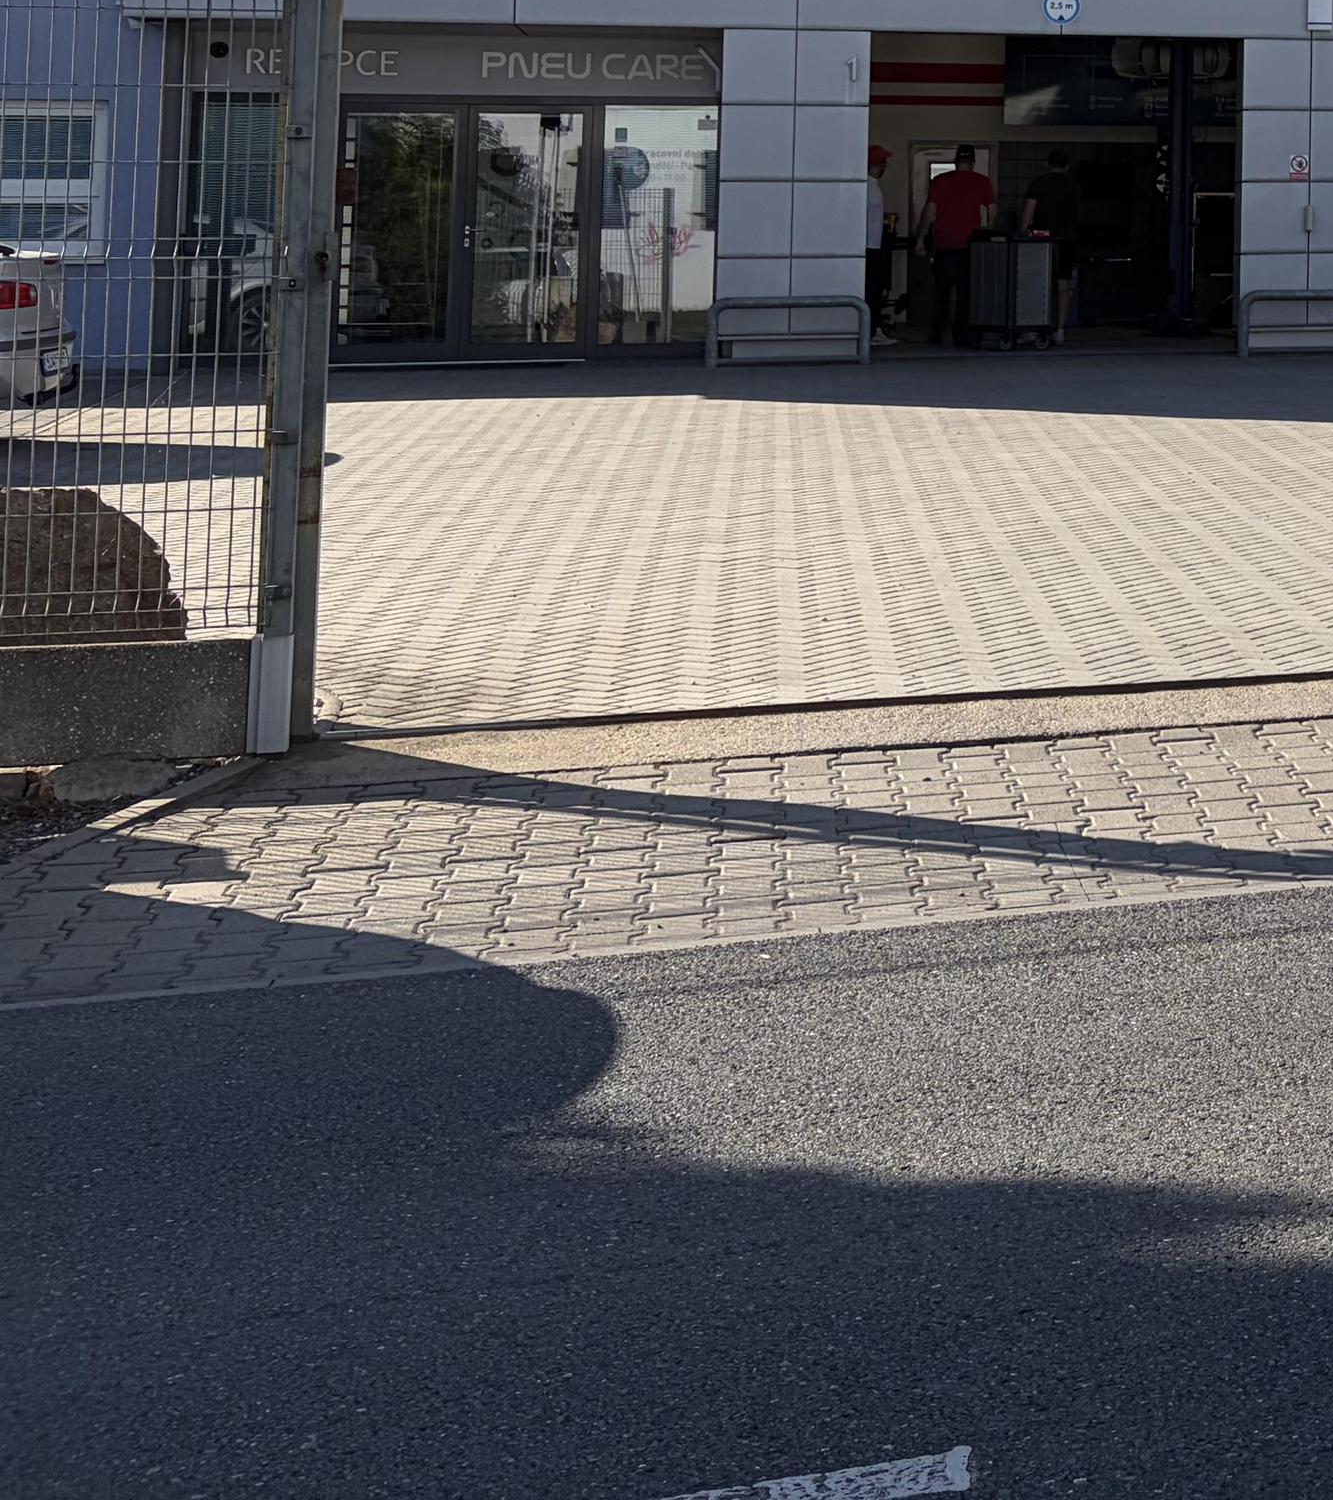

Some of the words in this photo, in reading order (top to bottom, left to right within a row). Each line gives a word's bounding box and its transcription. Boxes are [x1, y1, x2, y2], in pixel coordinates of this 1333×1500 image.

[246, 48, 399, 76] REPCE
[481, 51, 593, 79] PNEU
[602, 53, 703, 80] CARE
[846, 56, 857, 81] 1
